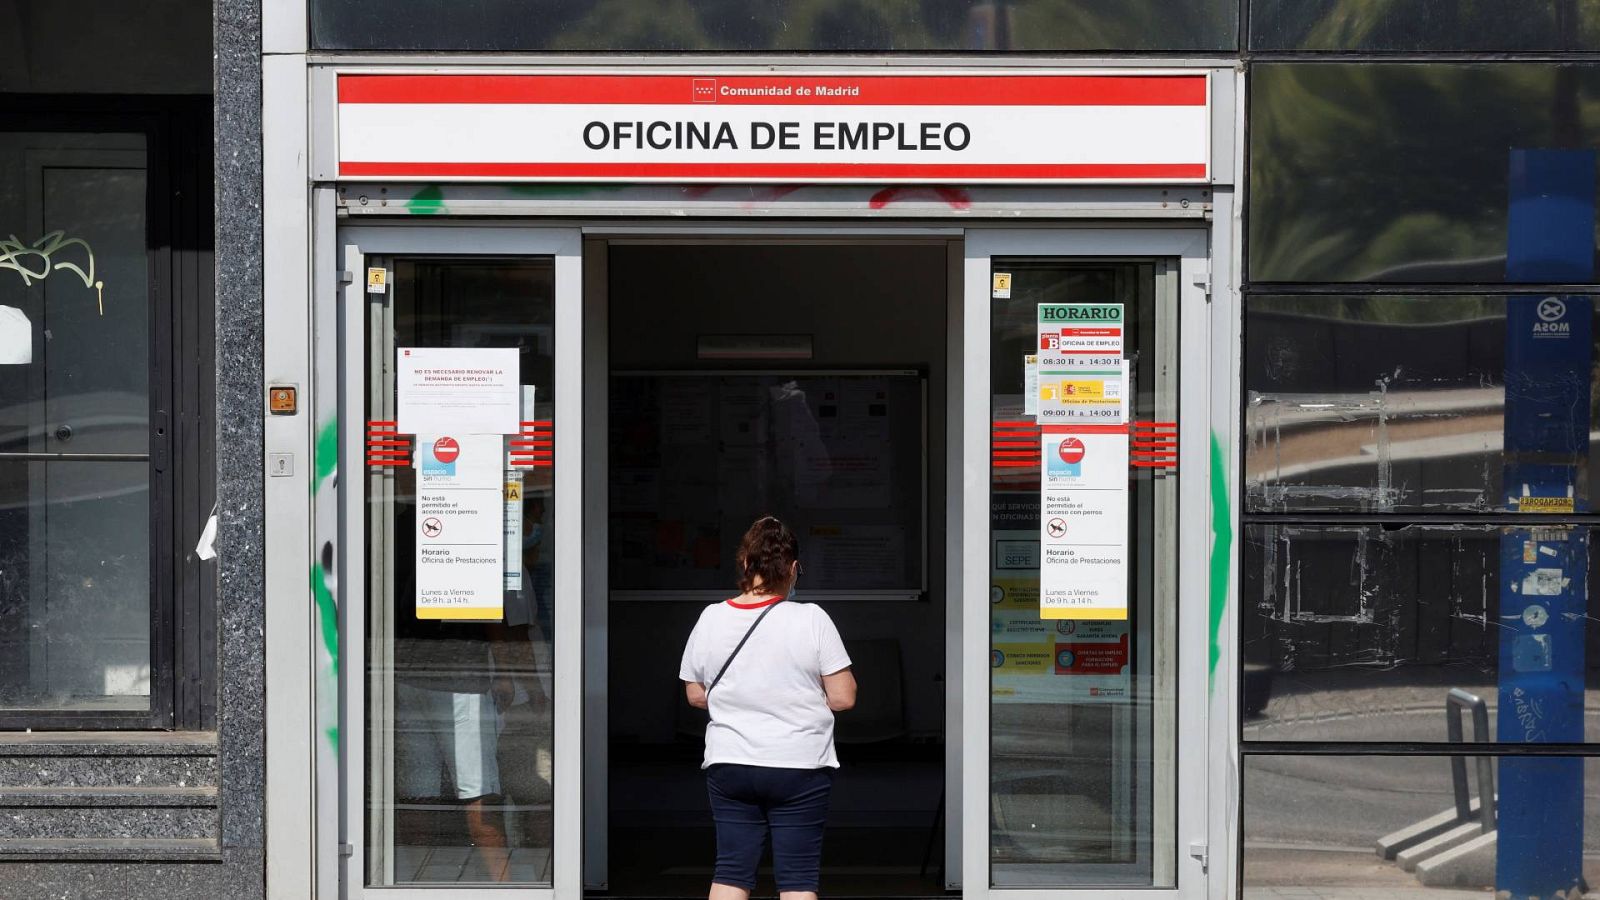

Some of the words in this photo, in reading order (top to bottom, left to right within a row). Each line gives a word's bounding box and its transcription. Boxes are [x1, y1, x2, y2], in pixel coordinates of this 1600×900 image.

[720, 86, 792, 96] Comunidad
[796, 86, 812, 96] de
[815, 86, 859, 96] Madrid
[582, 121, 738, 150] OFICINA
[750, 122, 800, 150] DE
[814, 122, 971, 151] EMPLEO
[1043, 308, 1120, 319] HORARIO
[1048, 339, 1058, 349] B
[1005, 556, 1031, 565] SEPE
